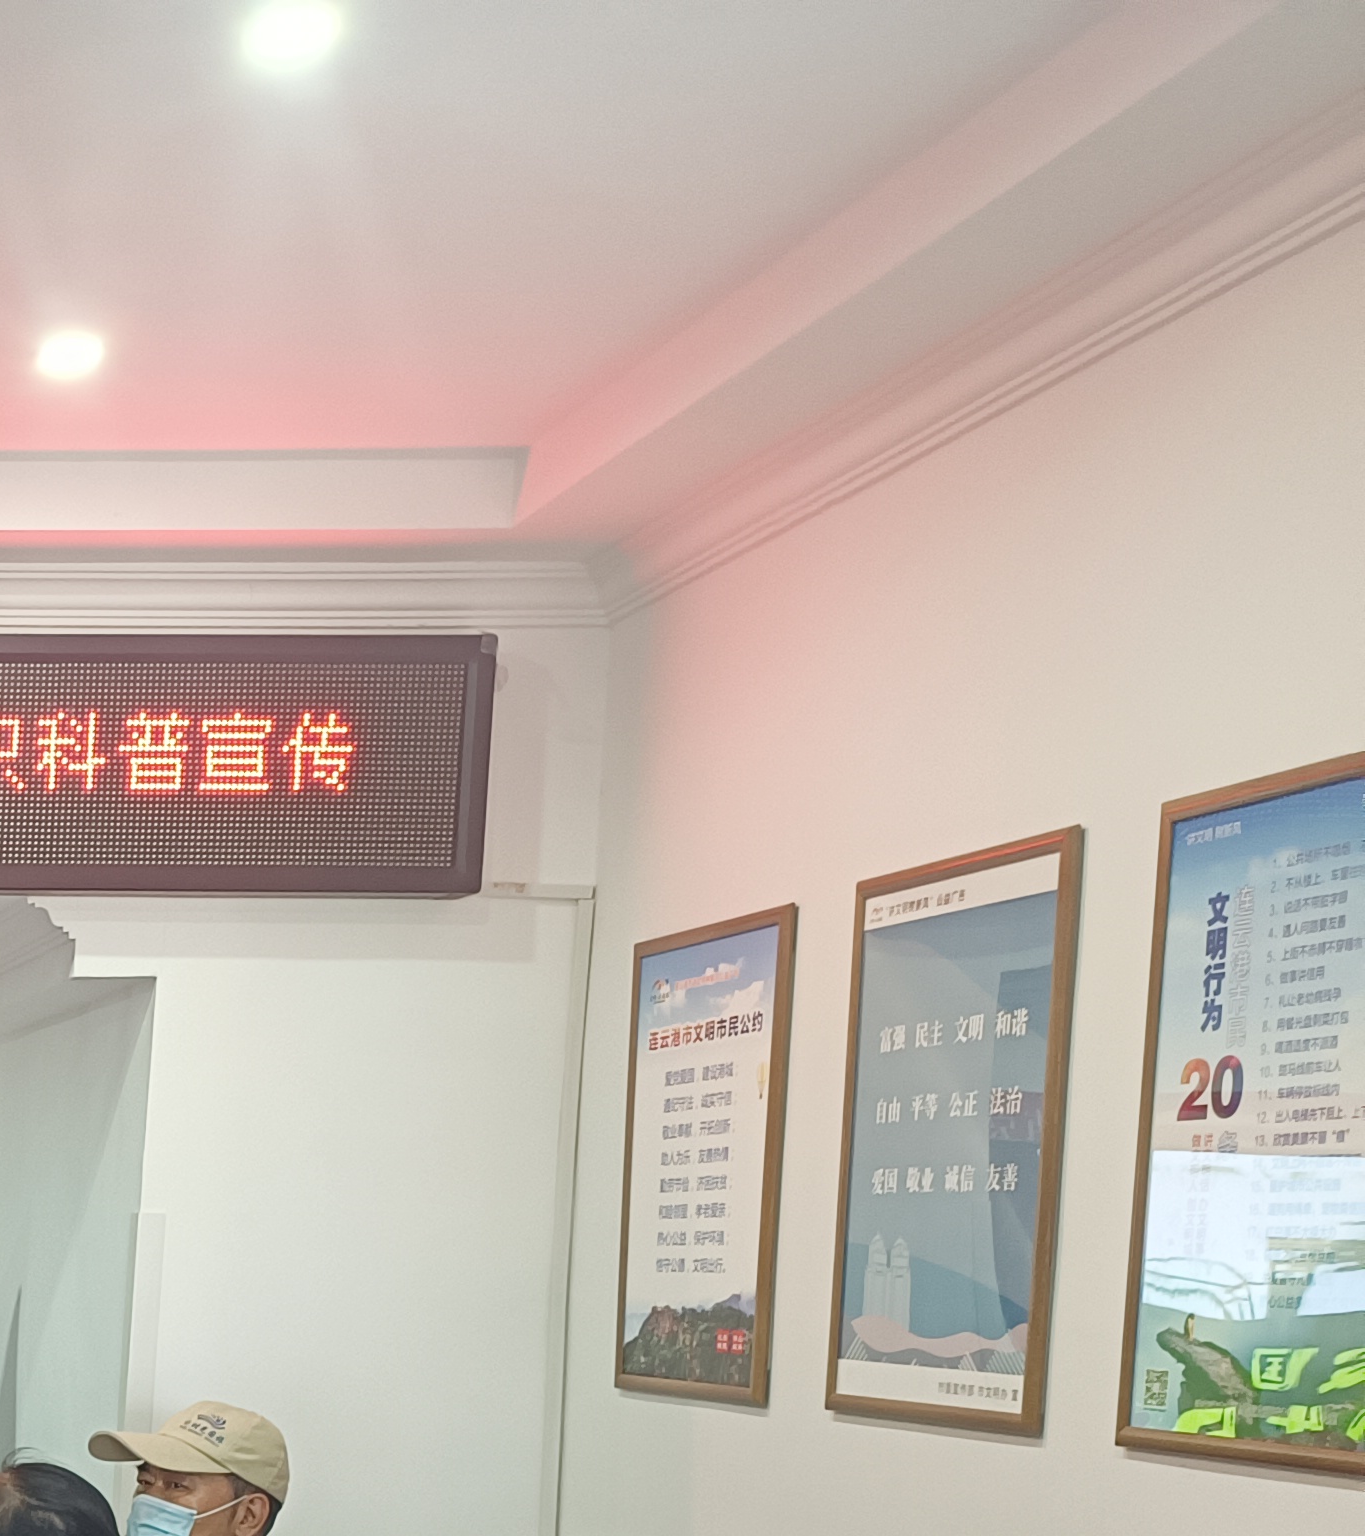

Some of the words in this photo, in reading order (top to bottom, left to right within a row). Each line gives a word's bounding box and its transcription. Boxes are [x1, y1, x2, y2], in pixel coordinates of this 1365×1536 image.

[1201, 891, 1230, 1033] 文明行为
[649, 1010, 763, 1051] 连云港市文明市民公约
[880, 1024, 906, 1053] 富强
[915, 1020, 943, 1048] 民主
[953, 1013, 985, 1045] 文明
[995, 1007, 1029, 1039] 和谐
[876, 1096, 901, 1124] 自由
[911, 1093, 939, 1121] 平等
[949, 1090, 979, 1118] 公正
[989, 1085, 1023, 1115] 法治
[1176, 1055, 1244, 1121] 20
[872, 1167, 898, 1195] 爱国
[906, 1166, 934, 1193] 敬业
[944, 1165, 976, 1193] 诚信
[985, 1163, 1018, 1192] 友善
